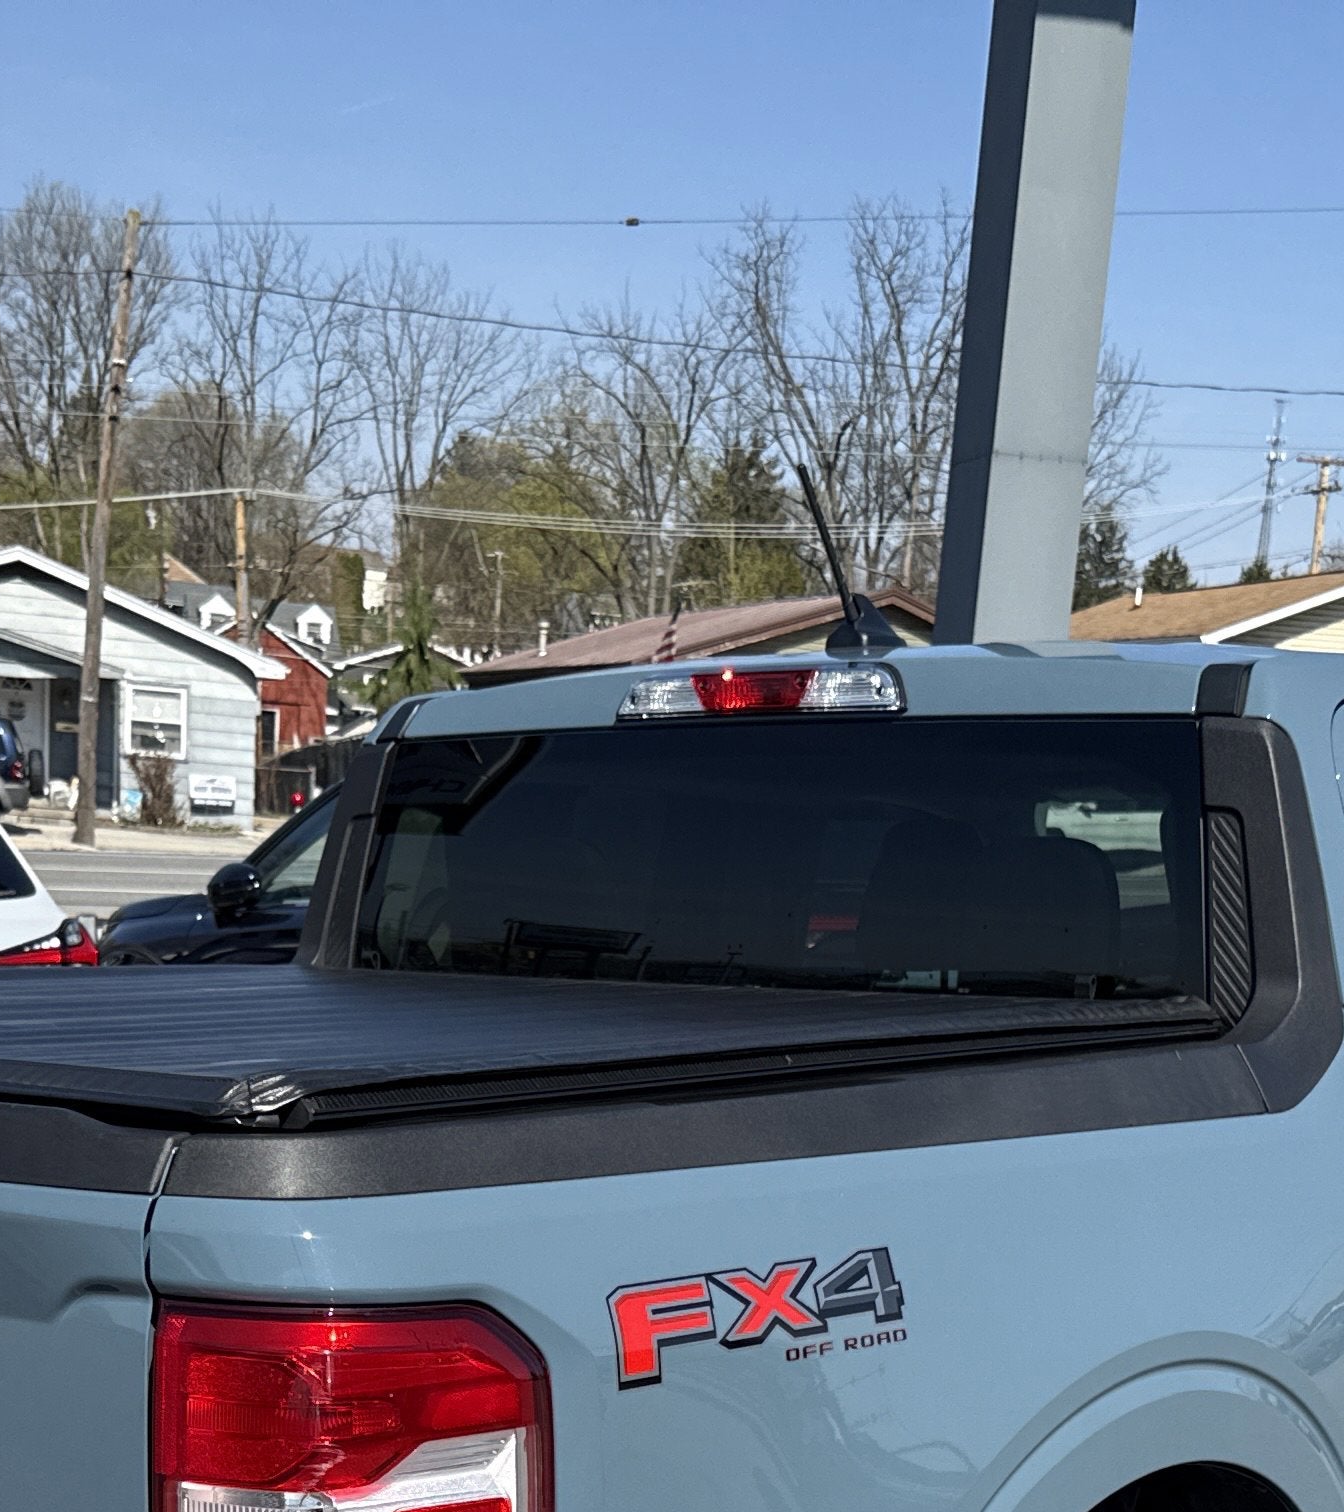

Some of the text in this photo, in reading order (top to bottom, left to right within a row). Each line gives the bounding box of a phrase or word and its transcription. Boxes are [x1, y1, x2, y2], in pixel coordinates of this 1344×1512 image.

[606, 1247, 905, 1390] FX4
[785, 1328, 907, 1362] OFF ROAD
